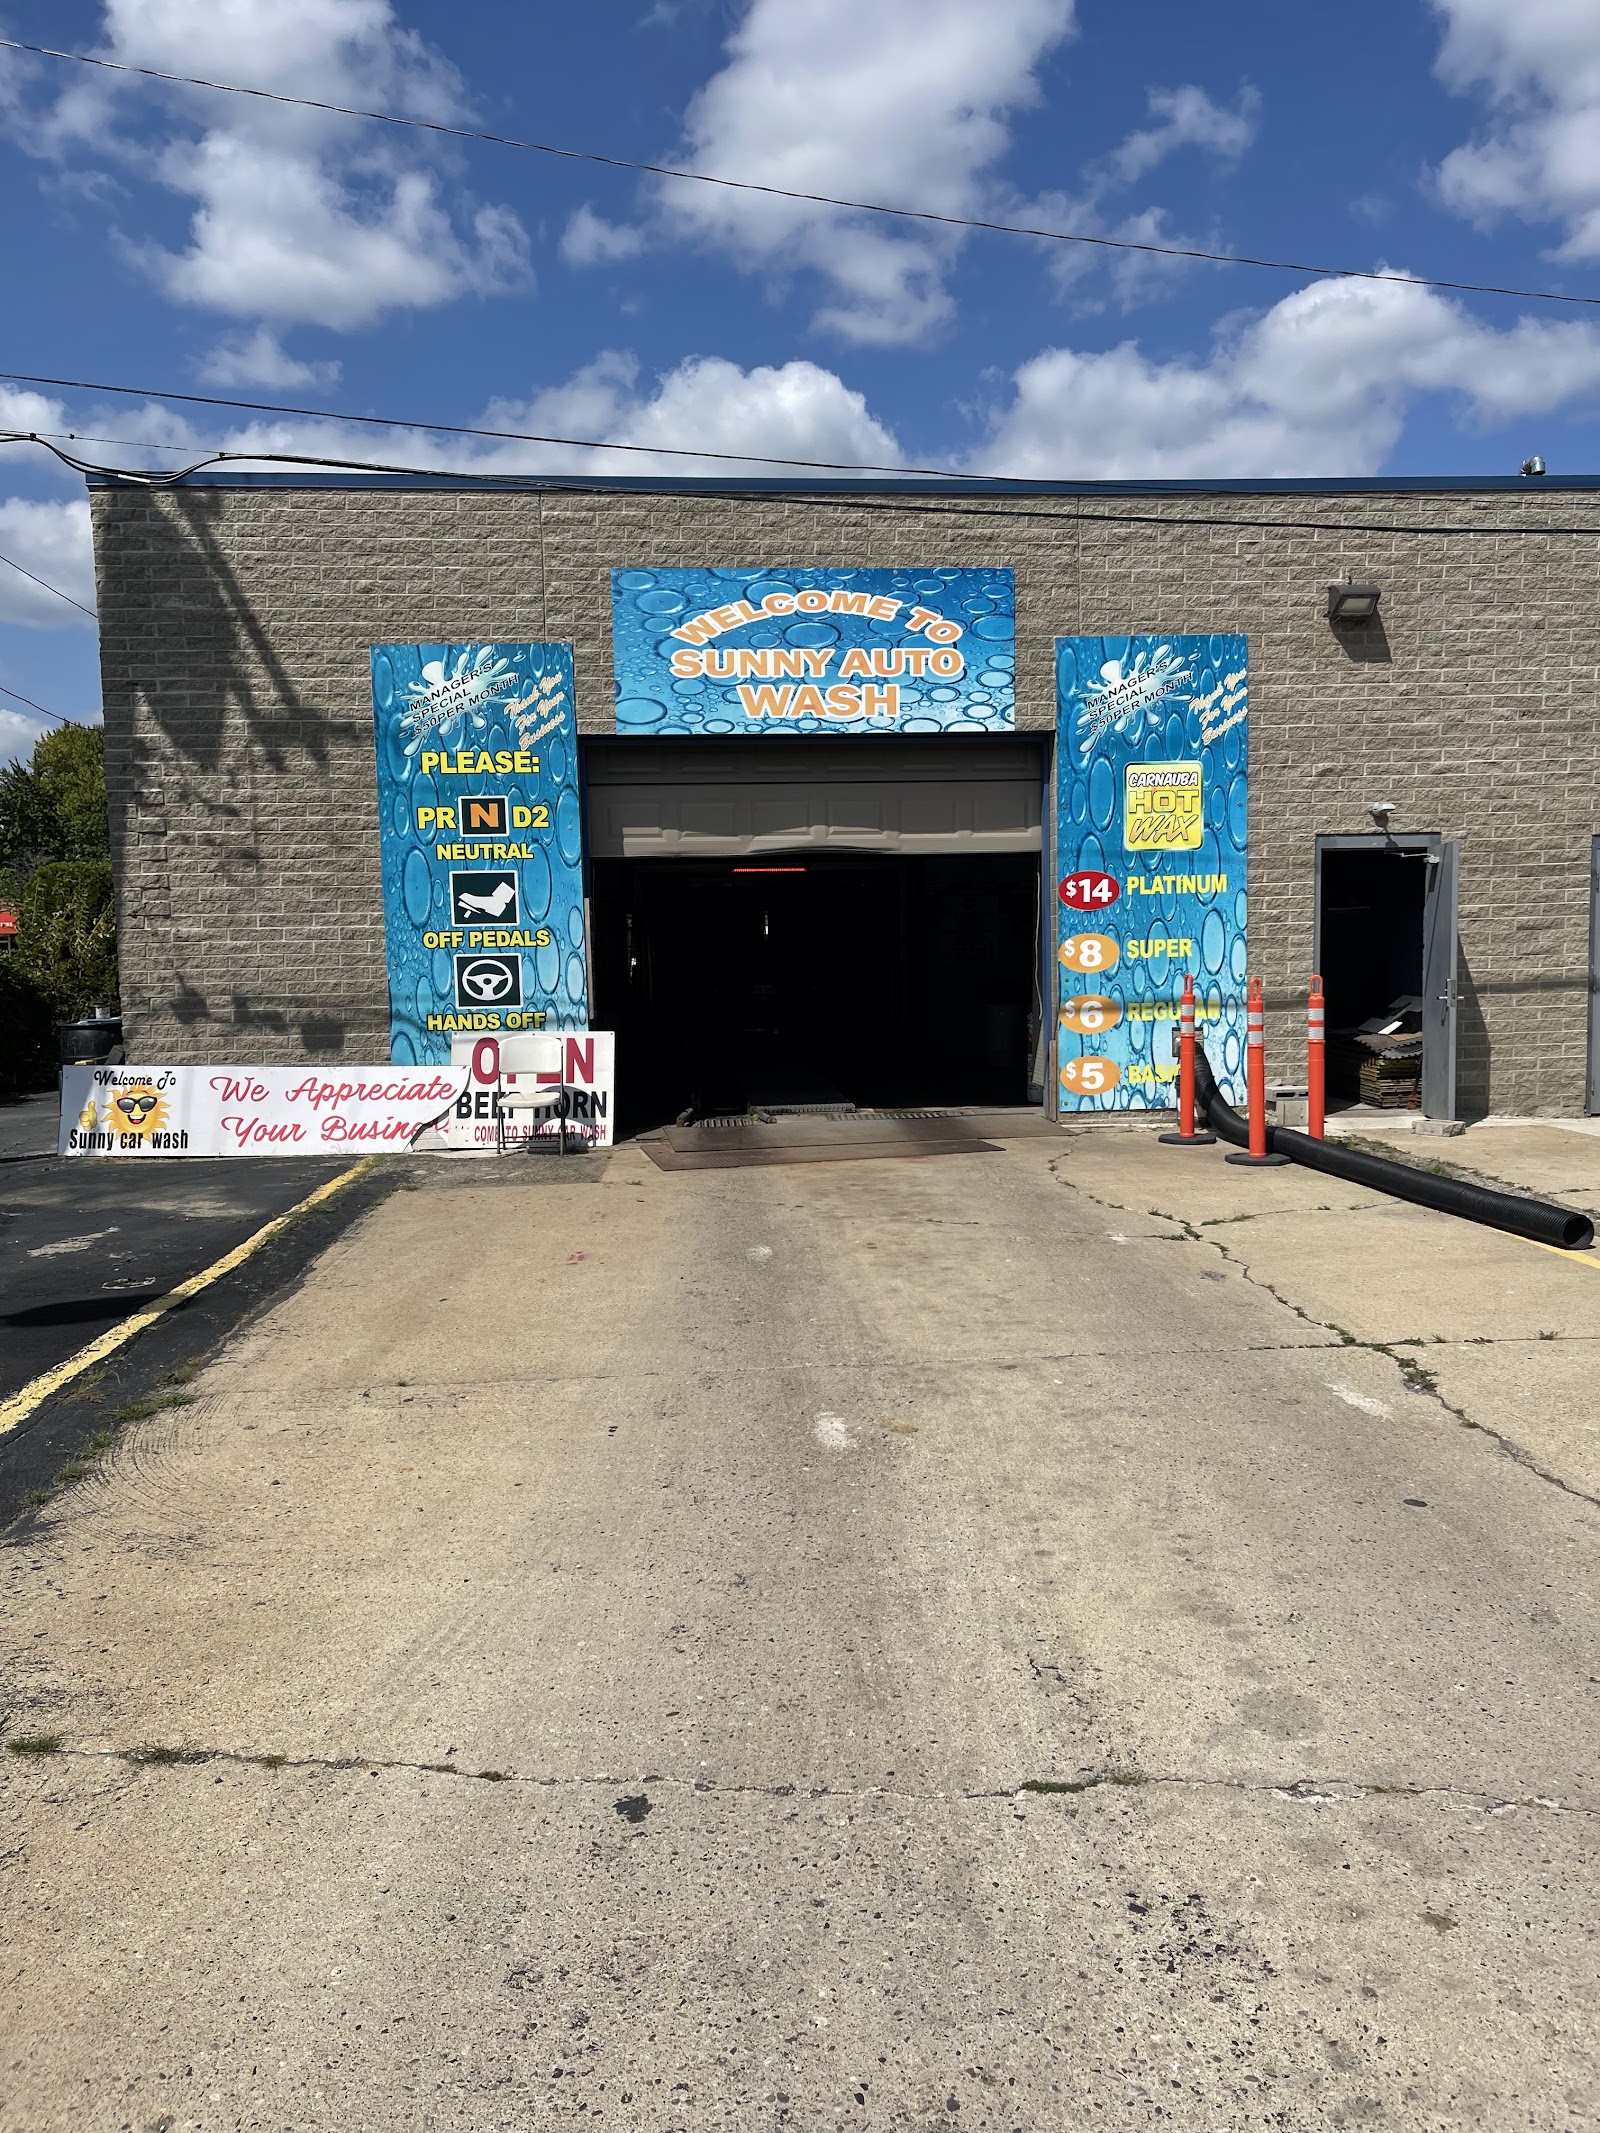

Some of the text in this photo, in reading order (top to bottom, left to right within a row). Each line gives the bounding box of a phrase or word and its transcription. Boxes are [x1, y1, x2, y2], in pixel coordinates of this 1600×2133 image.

[670, 590, 963, 646] WELCOME TO
[670, 648, 964, 678] SUNNY AUTO
[409, 663, 493, 712] MANAGER'S
[540, 672, 562, 696] You
[1087, 661, 1169, 709] MANAGER'S
[1145, 672, 1193, 702] MONTH
[412, 688, 472, 723] SPECIAL
[414, 674, 519, 735] $50PER MONTH
[736, 683, 900, 718] WASH
[1089, 686, 1148, 720] SPECIAL
[519, 711, 565, 751] Business
[1202, 706, 1248, 745] Business
[421, 751, 540, 774] PLEASE:
[1129, 772, 1198, 788] CARNAUBA
[1128, 790, 1199, 814] HOT
[417, 806, 456, 829] PR
[512, 805, 549, 828] D2
[1129, 814, 1199, 844] WAX
[437, 843, 534, 860] NEUTRAL
[1066, 874, 1227, 902] $14 PLATINUM
[423, 930, 550, 948] OFF PEDALS
[1064, 938, 1192, 967] $8 SUPER
[427, 1012, 546, 1031] HANDS OFF
[1065, 1000, 1220, 1028] $6 REGUAR
[472, 1037, 594, 1084] ON
[94, 1070, 176, 1090] Welcome To
[1066, 1062, 1104, 1090] $5
[209, 1075, 458, 1111] We Appreciate
[70, 1129, 188, 1150] Sunny car wash
[220, 1116, 307, 1148] Your
[506, 1125, 518, 1142] TO
[580, 1124, 606, 1141] WASH
